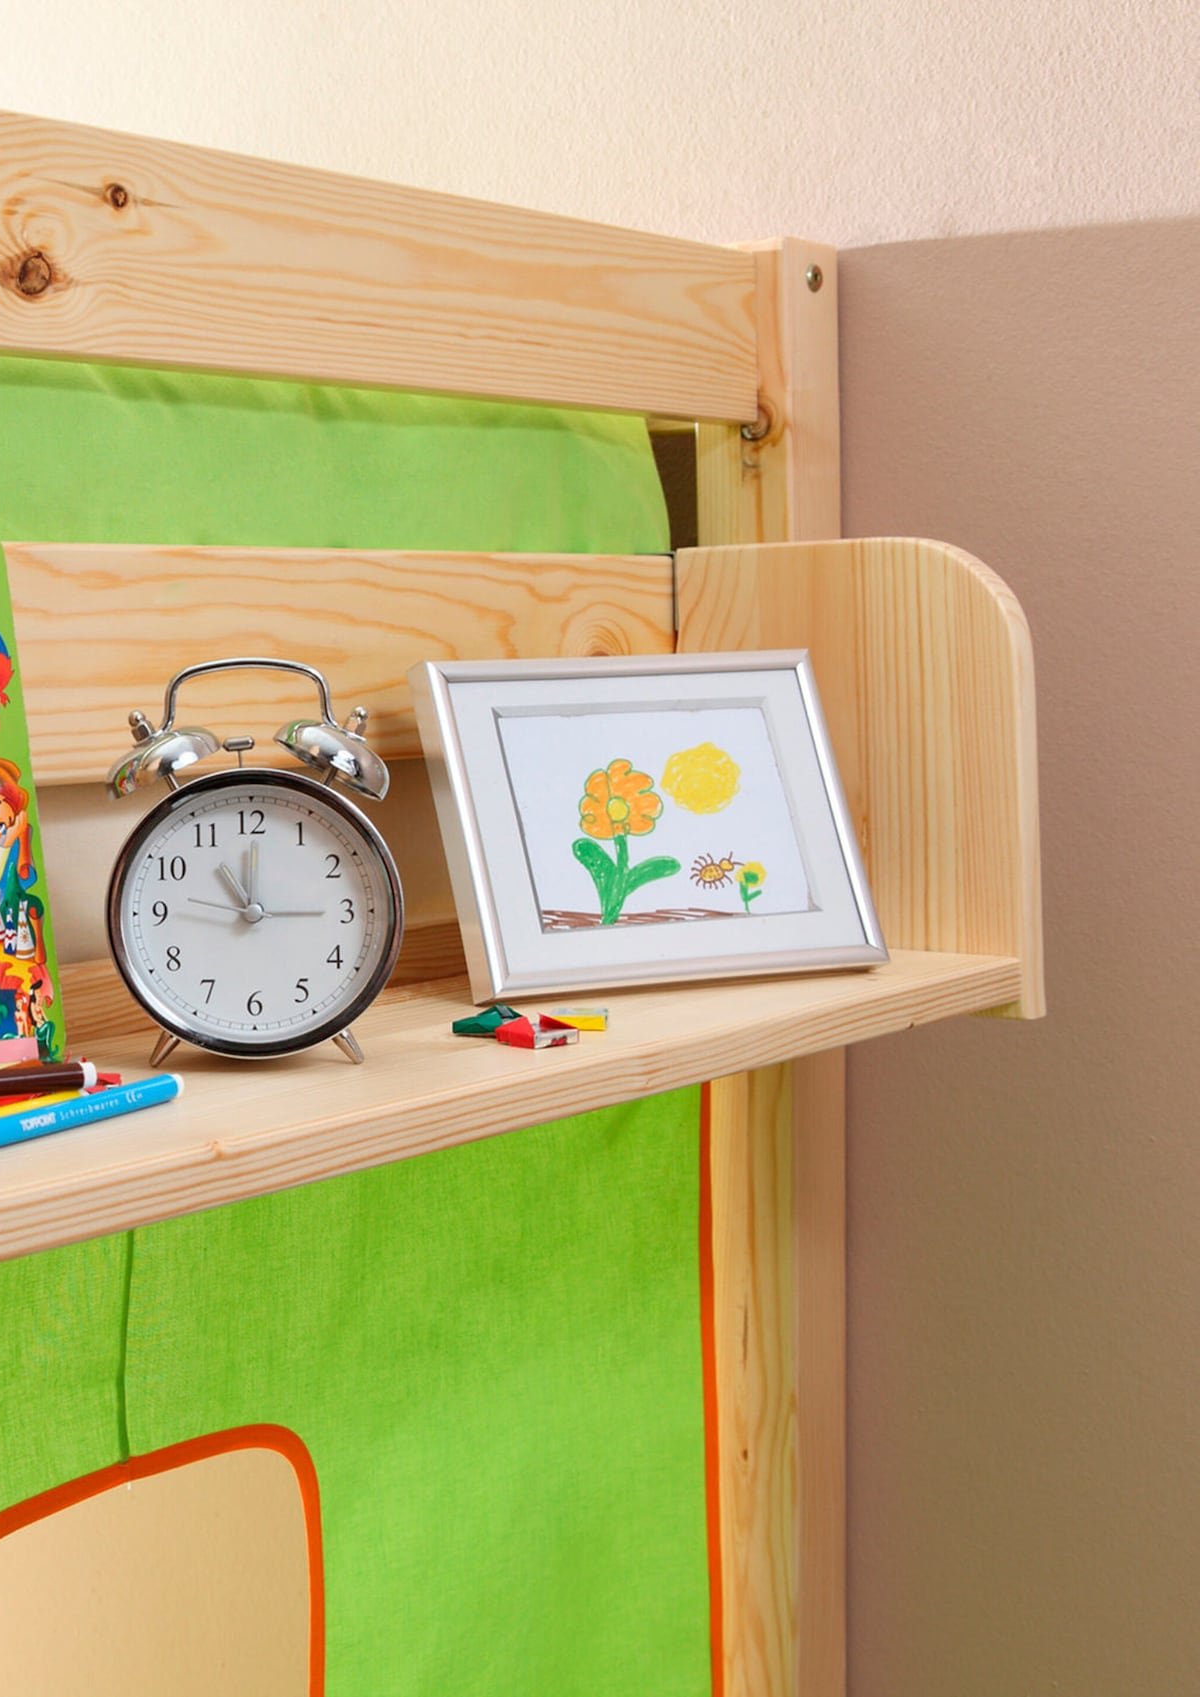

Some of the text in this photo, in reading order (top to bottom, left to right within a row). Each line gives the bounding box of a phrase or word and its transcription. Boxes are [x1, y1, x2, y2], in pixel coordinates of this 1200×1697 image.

[194, 822, 217, 848] 11
[237, 809, 266, 835] 12
[295, 821, 305, 846] 1
[157, 855, 187, 881] 10
[325, 853, 342, 879] 2
[151, 900, 168, 926] 9
[339, 898, 355, 924] 3
[166, 945, 182, 972] 8
[326, 944, 344, 970] 4
[199, 978, 216, 1004] 7
[246, 990, 263, 1017] 6
[294, 977, 310, 1004] 5
